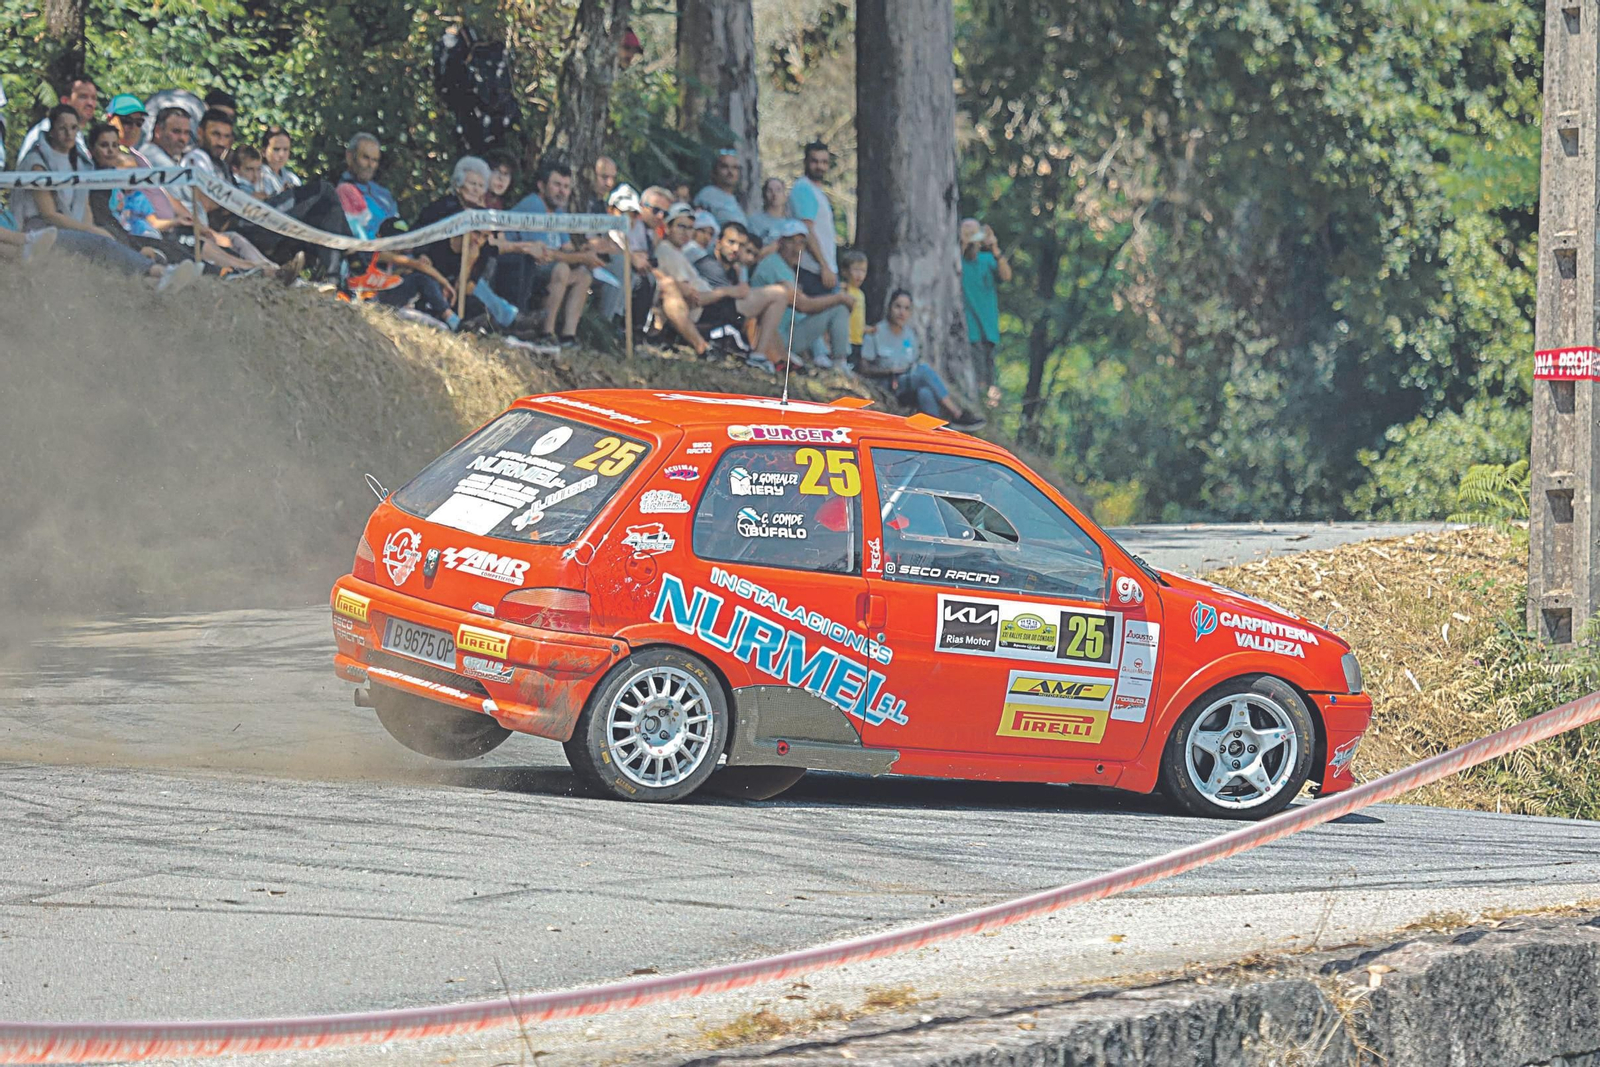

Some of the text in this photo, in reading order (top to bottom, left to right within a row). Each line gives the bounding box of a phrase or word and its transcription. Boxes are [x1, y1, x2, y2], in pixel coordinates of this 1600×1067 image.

[573, 436, 646, 477] 25
[795, 447, 861, 497] 25
[749, 525, 807, 539] BÚFALO
[773, 513, 804, 527] CONDE
[461, 547, 531, 579] AMR
[899, 564, 941, 578] SECO
[337, 594, 366, 618] PIRELLI
[710, 567, 893, 665] INSTALACIONES
[944, 605, 998, 625] KIA
[459, 629, 507, 654] PIRELLI
[946, 634, 964, 644] Rias
[965, 635, 991, 647] Motor
[1066, 615, 1106, 659] 25
[1220, 611, 1319, 645] CARPINTERIA
[393, 624, 455, 662] B 9675 OP
[650, 573, 886, 726] NURMEL
[1235, 631, 1305, 658] VALDEZA
[1011, 711, 1095, 736] PIRELLI
